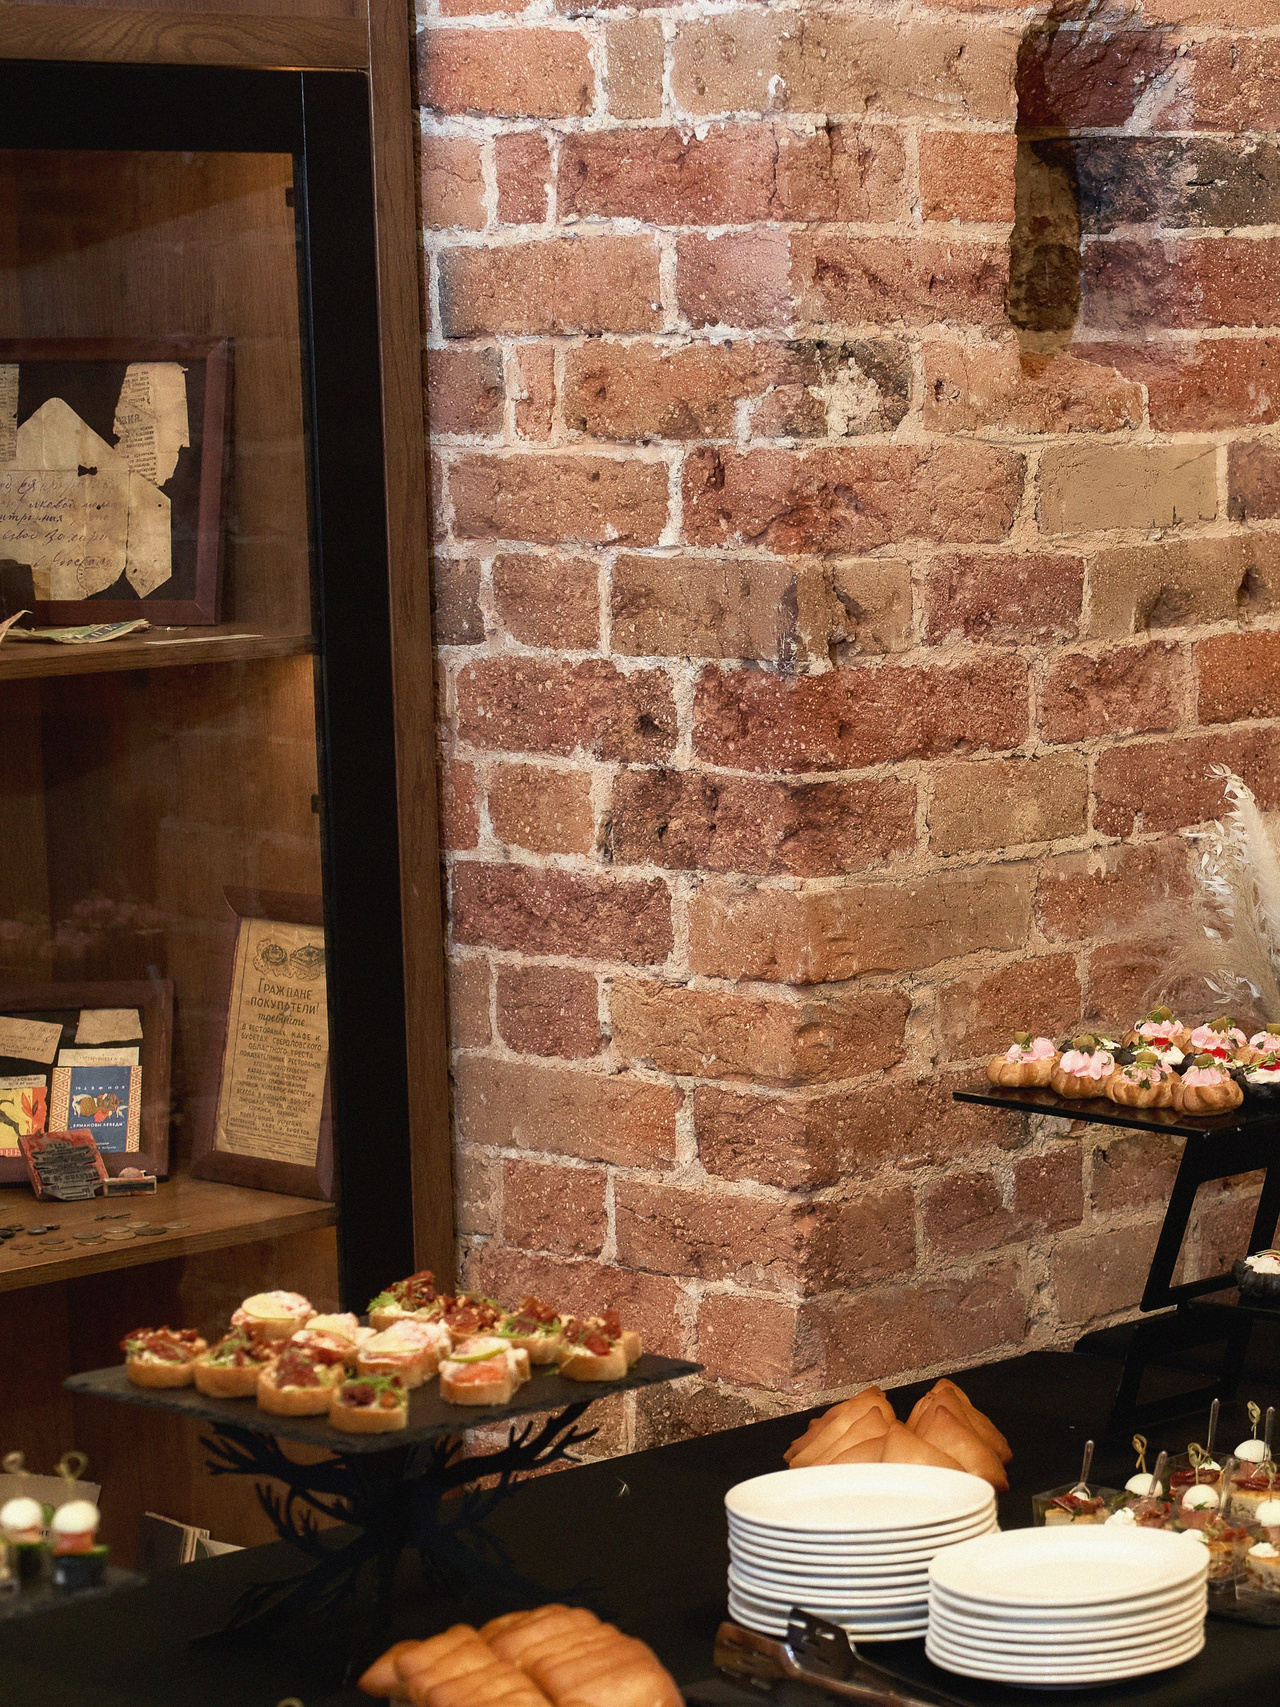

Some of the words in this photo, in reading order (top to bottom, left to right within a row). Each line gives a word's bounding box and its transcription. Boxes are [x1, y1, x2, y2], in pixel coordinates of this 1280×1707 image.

[250, 996, 320, 1015] ПОКУПАТЕЛИ!
[291, 1031, 311, 1041] КАФЕ
[272, 1037, 322, 1051] СВЕРДЛОВСКОГО
[290, 1049, 314, 1059] ТРЕСТА
